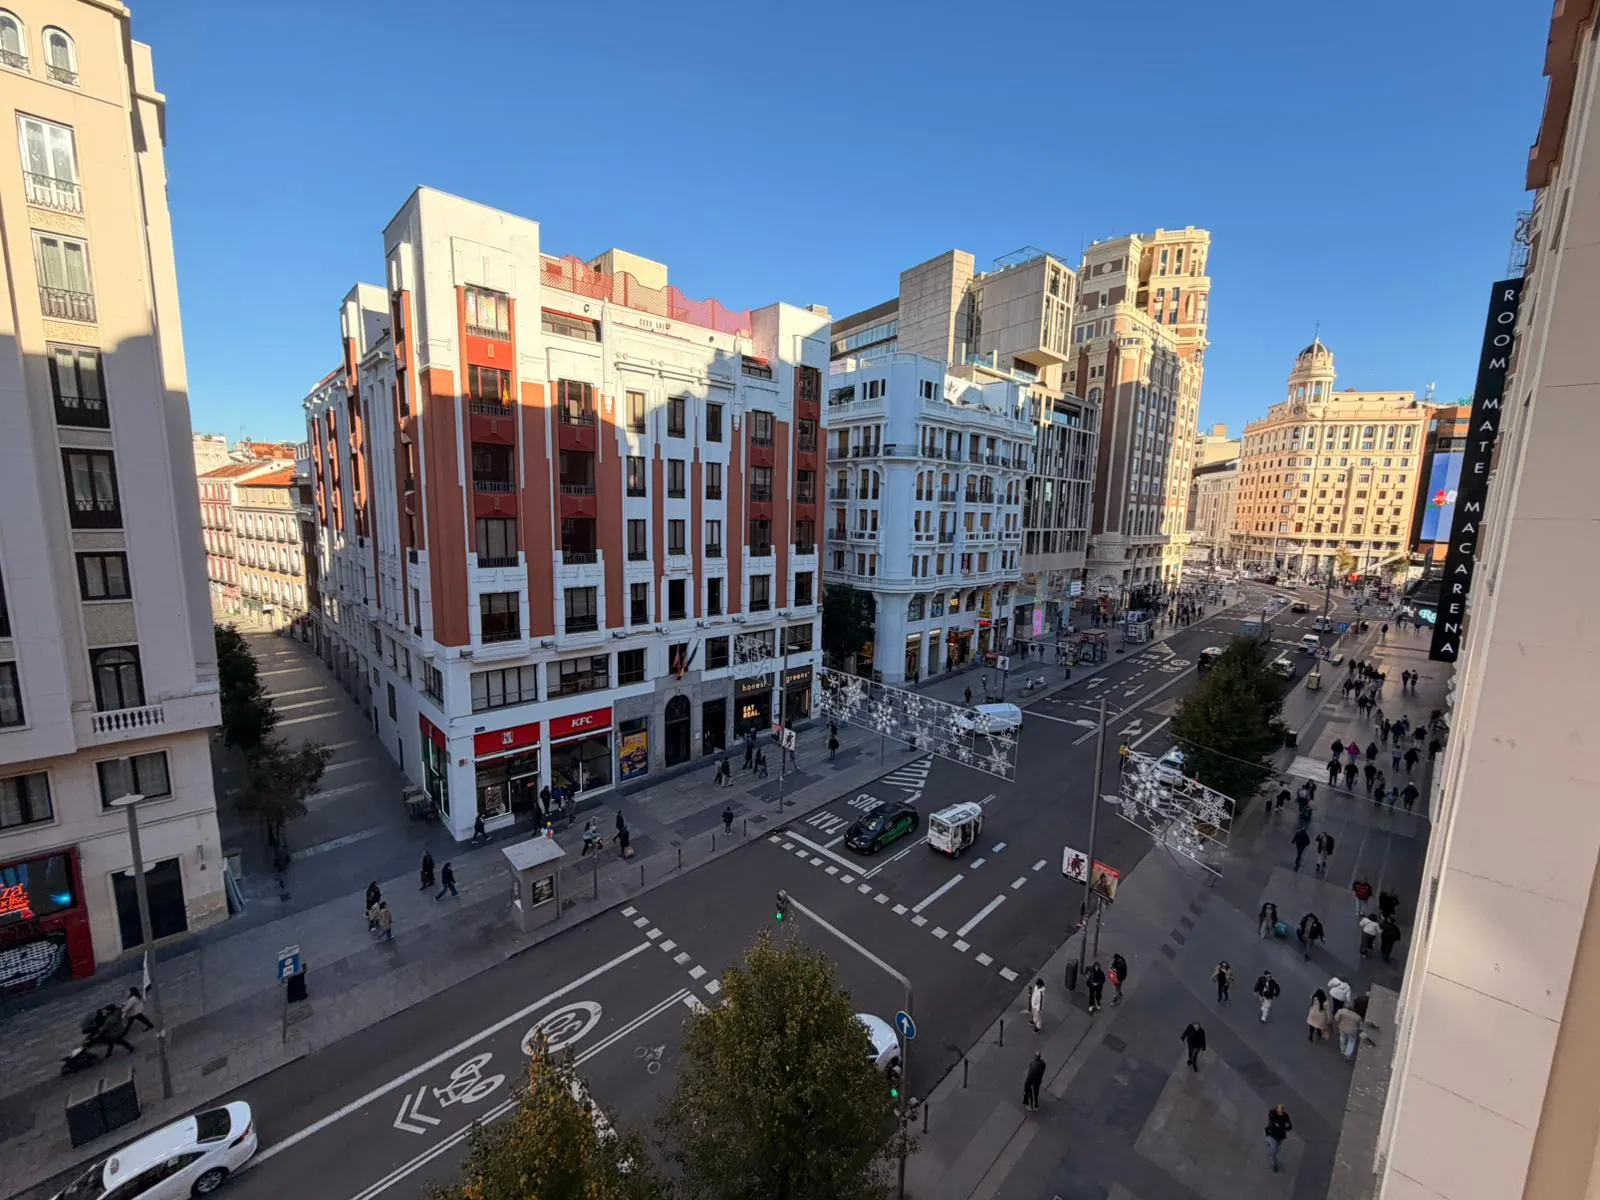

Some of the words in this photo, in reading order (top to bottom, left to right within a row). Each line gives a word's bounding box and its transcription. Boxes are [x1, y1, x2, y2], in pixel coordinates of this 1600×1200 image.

[1488, 289, 1515, 369] ROOM
[1474, 398, 1499, 474] MATE
[1440, 501, 1480, 653] MACARENA
[571, 715, 592, 727] KFC
[805, 810, 849, 835] TAXI
[847, 793, 886, 812] BUS
